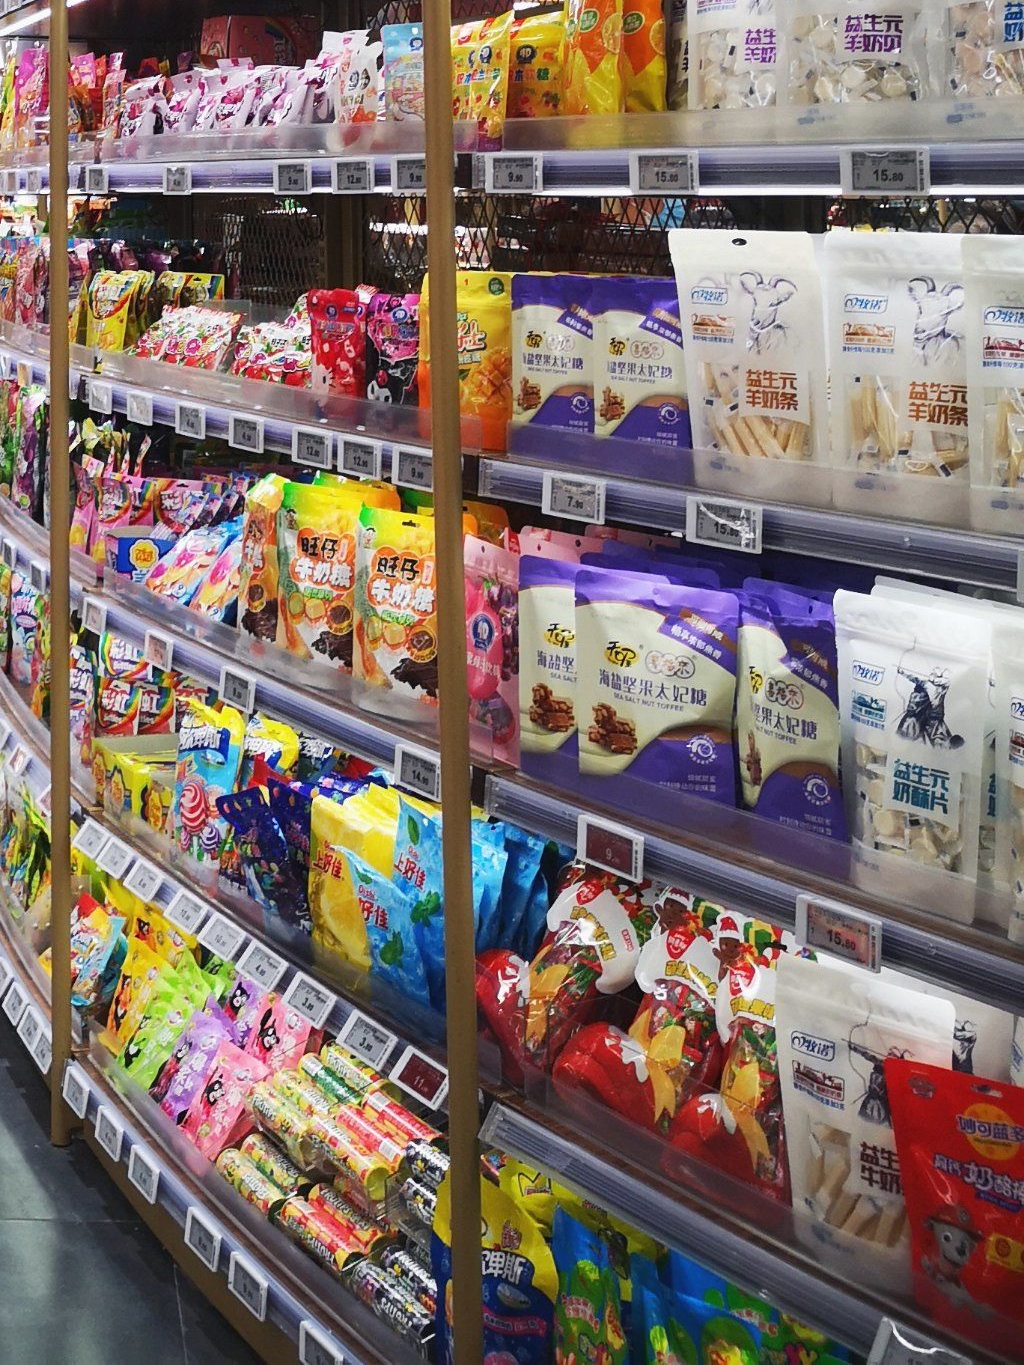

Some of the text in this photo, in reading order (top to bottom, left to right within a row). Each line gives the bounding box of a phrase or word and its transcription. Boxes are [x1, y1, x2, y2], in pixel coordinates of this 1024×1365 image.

[844, 14, 903, 33] 益生元
[655, 170, 679, 184] 15.80
[873, 170, 904, 184] 15.80
[746, 368, 798, 390] 益生元
[746, 389, 799, 412] 羊奶条
[908, 381, 968, 404] 益生元
[908, 402, 969, 427] 羊奶条
[301, 536, 339, 559] 旺仔
[295, 557, 352, 588] 牛奶糖
[376, 556, 420, 581] 旺仔
[371, 578, 435, 613] 牛奶糖
[599, 669, 707, 707] 海盐坚果太妃糖
[613, 692, 685, 713] SEA SALT NUT TOFFEE
[894, 758, 950, 793] 益生元
[892, 781, 948, 815] 奶酥片
[313, 849, 343, 879] 上好佳
[394, 852, 426, 892] 上好佳
[827, 928, 856, 951] 15.80
